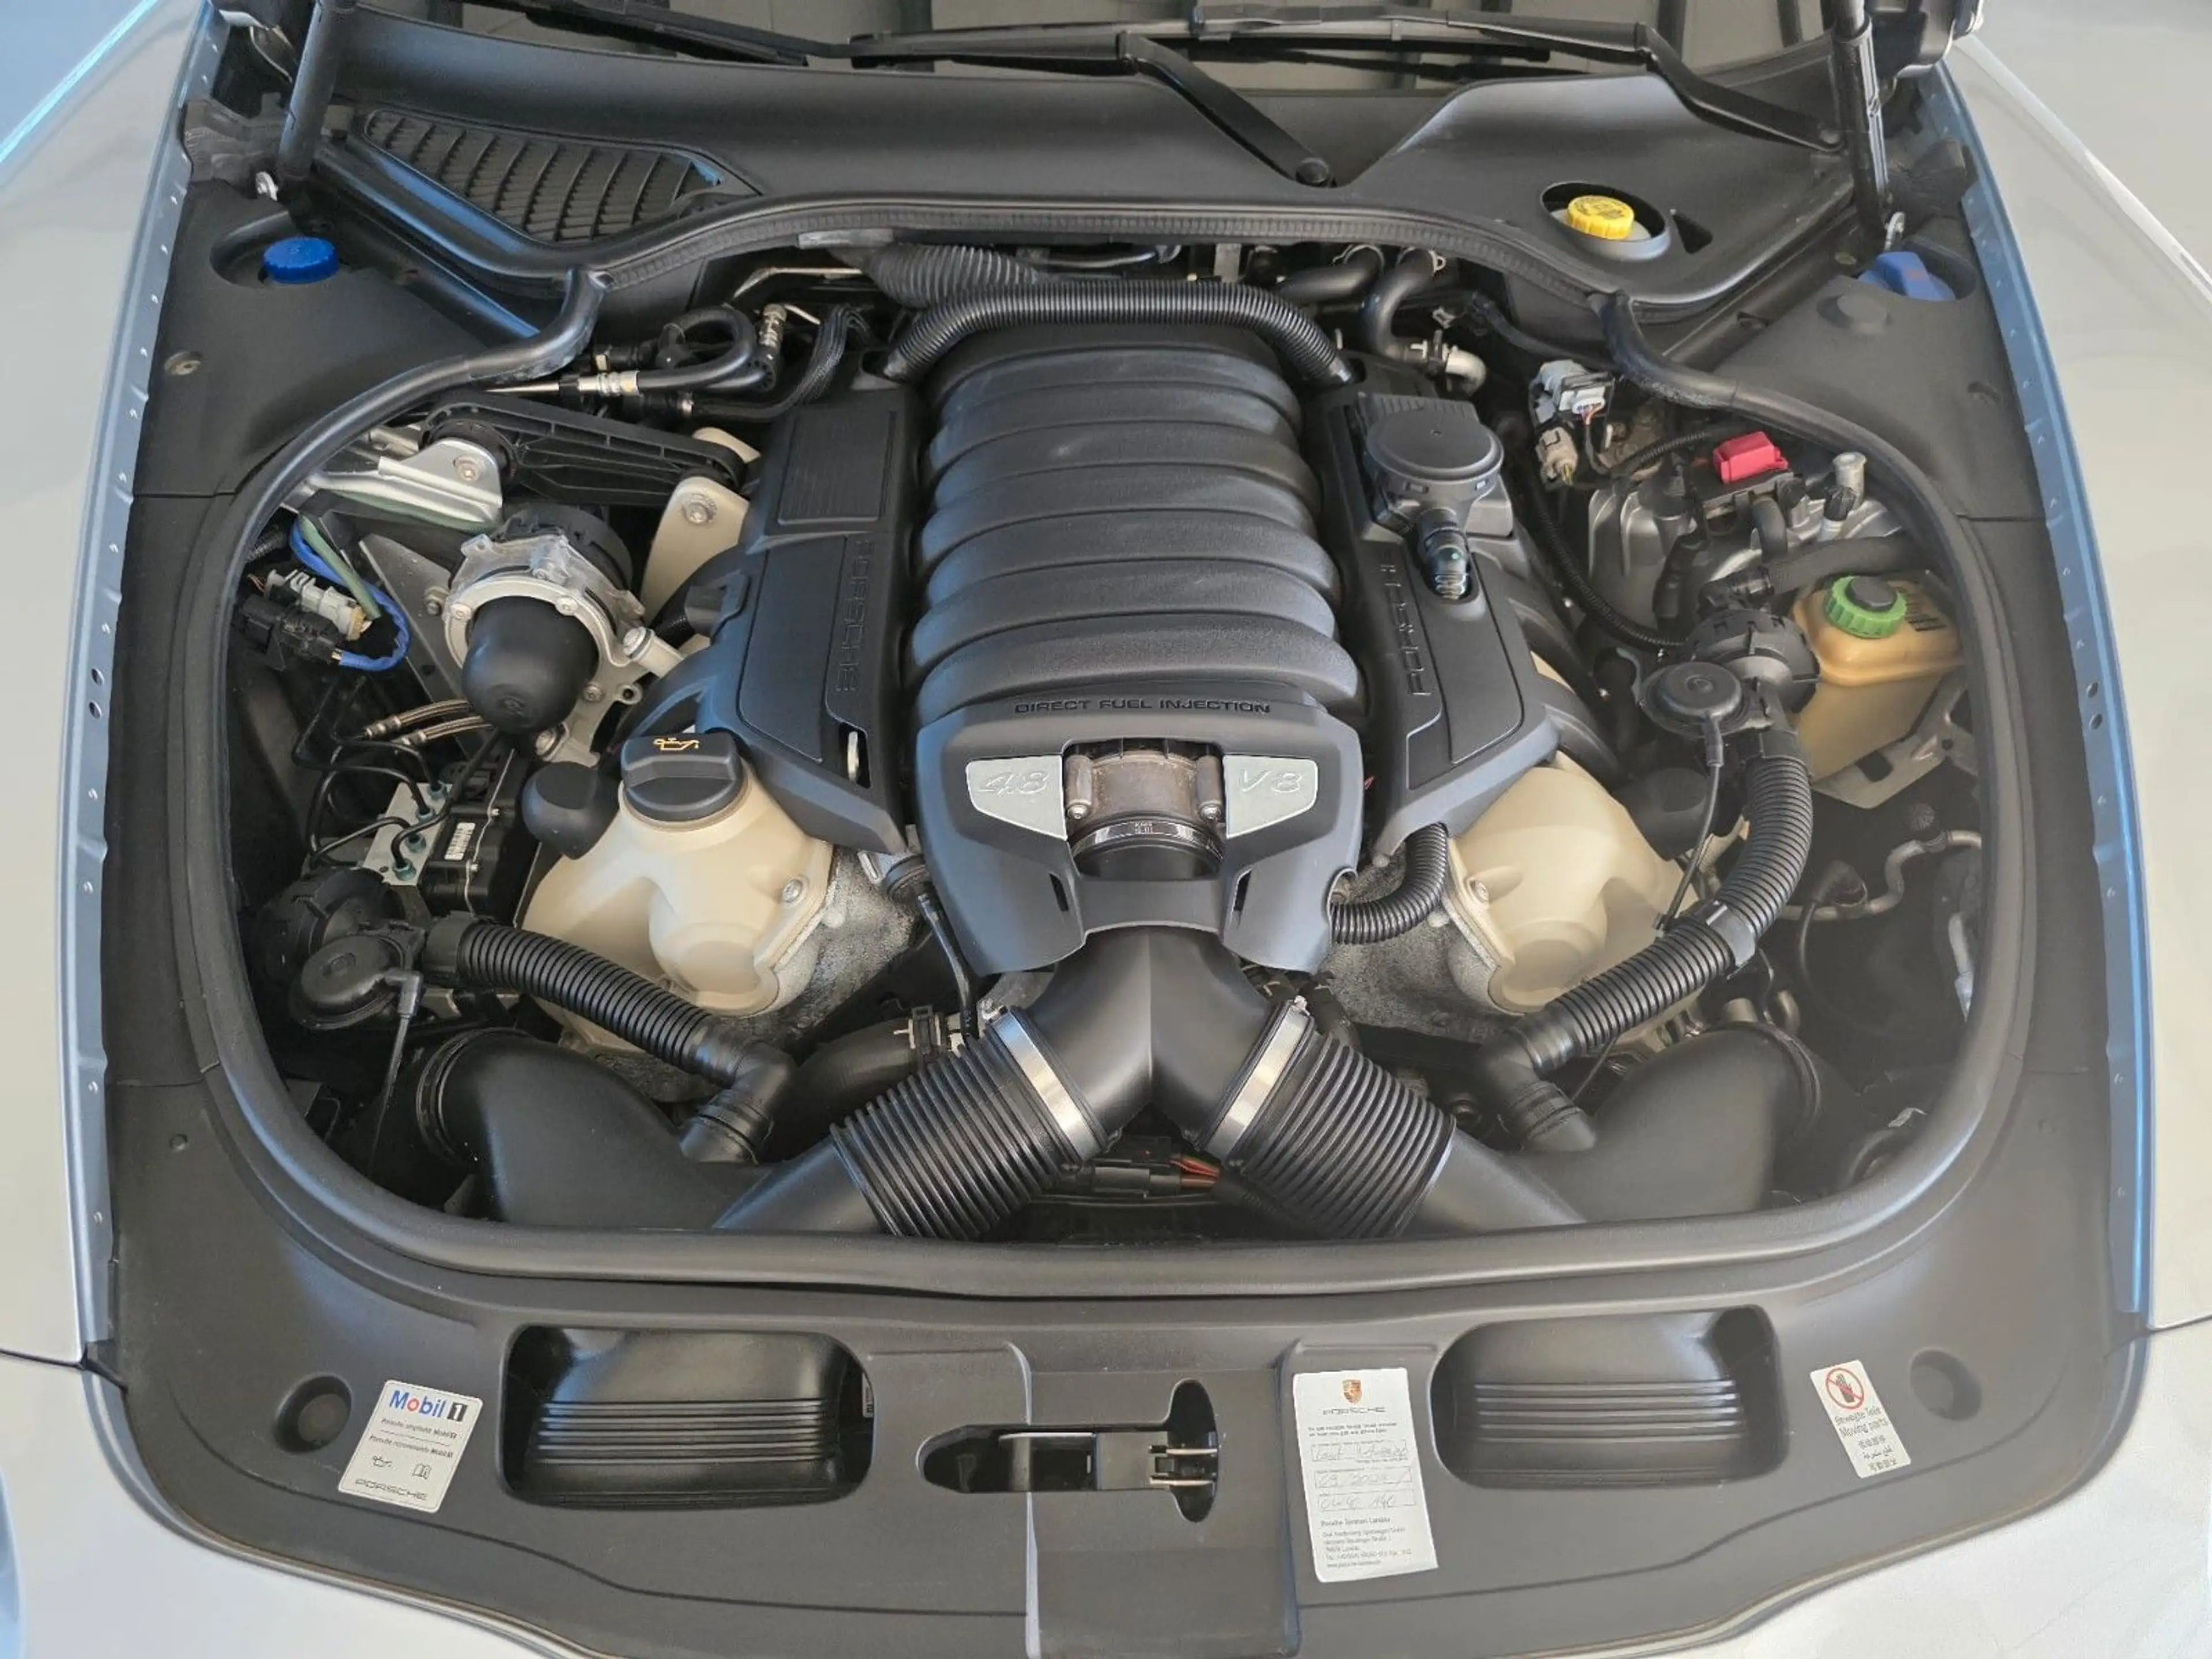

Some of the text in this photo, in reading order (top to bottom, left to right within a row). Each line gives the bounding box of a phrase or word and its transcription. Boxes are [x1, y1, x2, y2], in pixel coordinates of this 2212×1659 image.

[835, 540, 873, 692] PORSCHE
[1378, 550, 1432, 696] PORSCHE
[1014, 699, 1271, 714] DIRECT FUEL INJECTION
[389, 1390, 446, 1418] Mobil
[355, 1479, 428, 1501] PORSCHE
